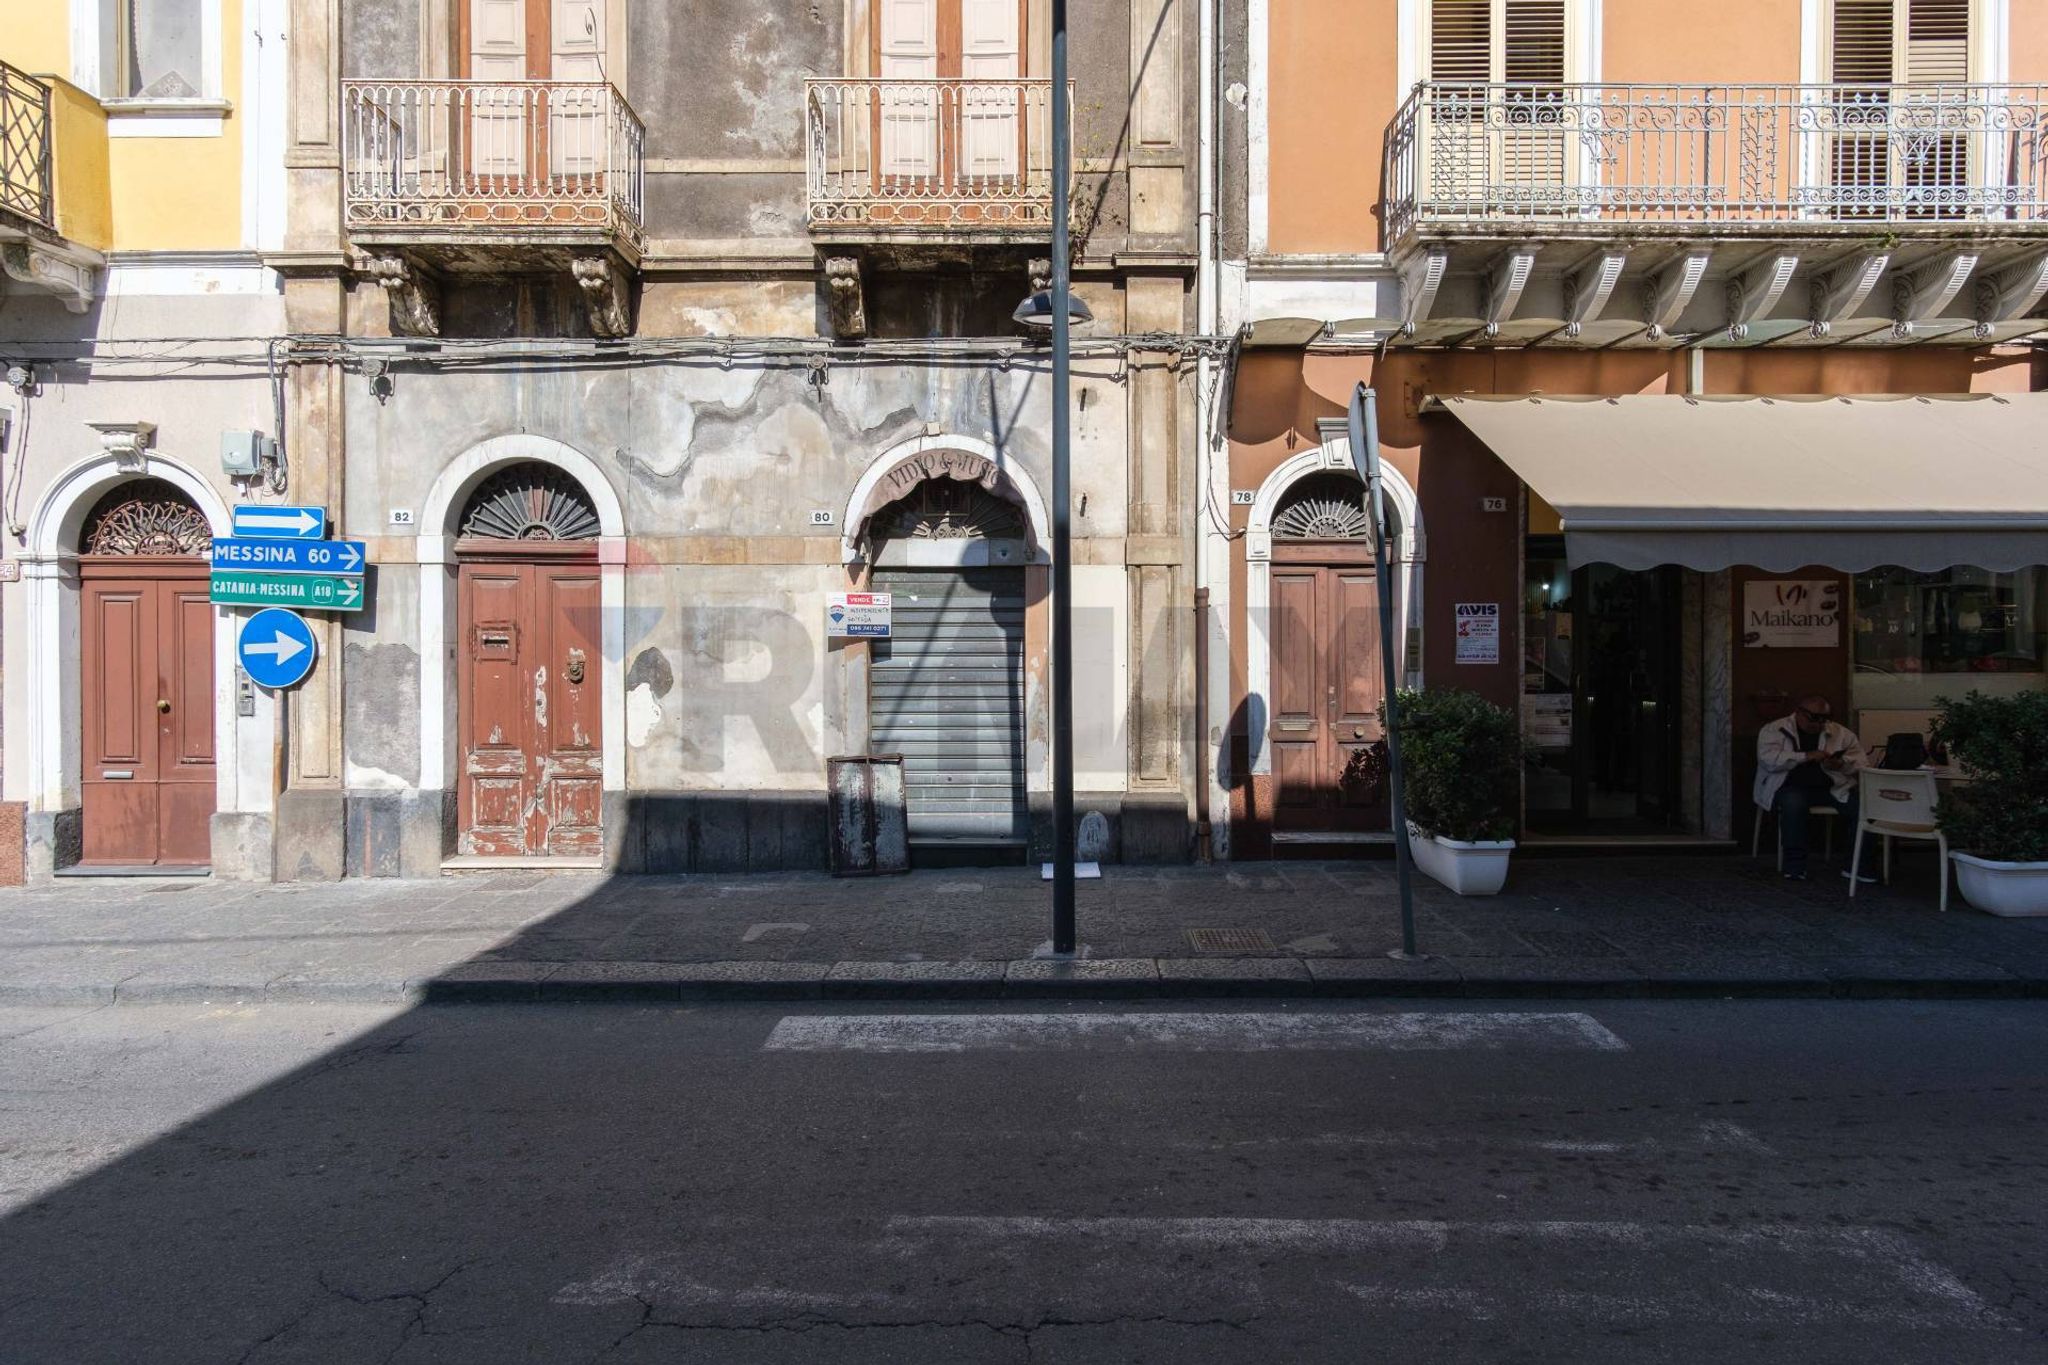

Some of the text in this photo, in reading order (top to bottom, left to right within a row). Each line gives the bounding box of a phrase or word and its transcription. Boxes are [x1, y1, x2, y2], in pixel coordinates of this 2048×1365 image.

[1236, 492, 1251, 502] 78
[1487, 500, 1501, 509] 76
[394, 512, 409, 521] 82
[814, 512, 830, 522] 80
[214, 545, 331, 564] MESSINA 60
[212, 581, 331, 597] CATANIA-MESSINA A18
[1457, 604, 1497, 616] AVIS
[1750, 608, 1834, 627] Maikano
